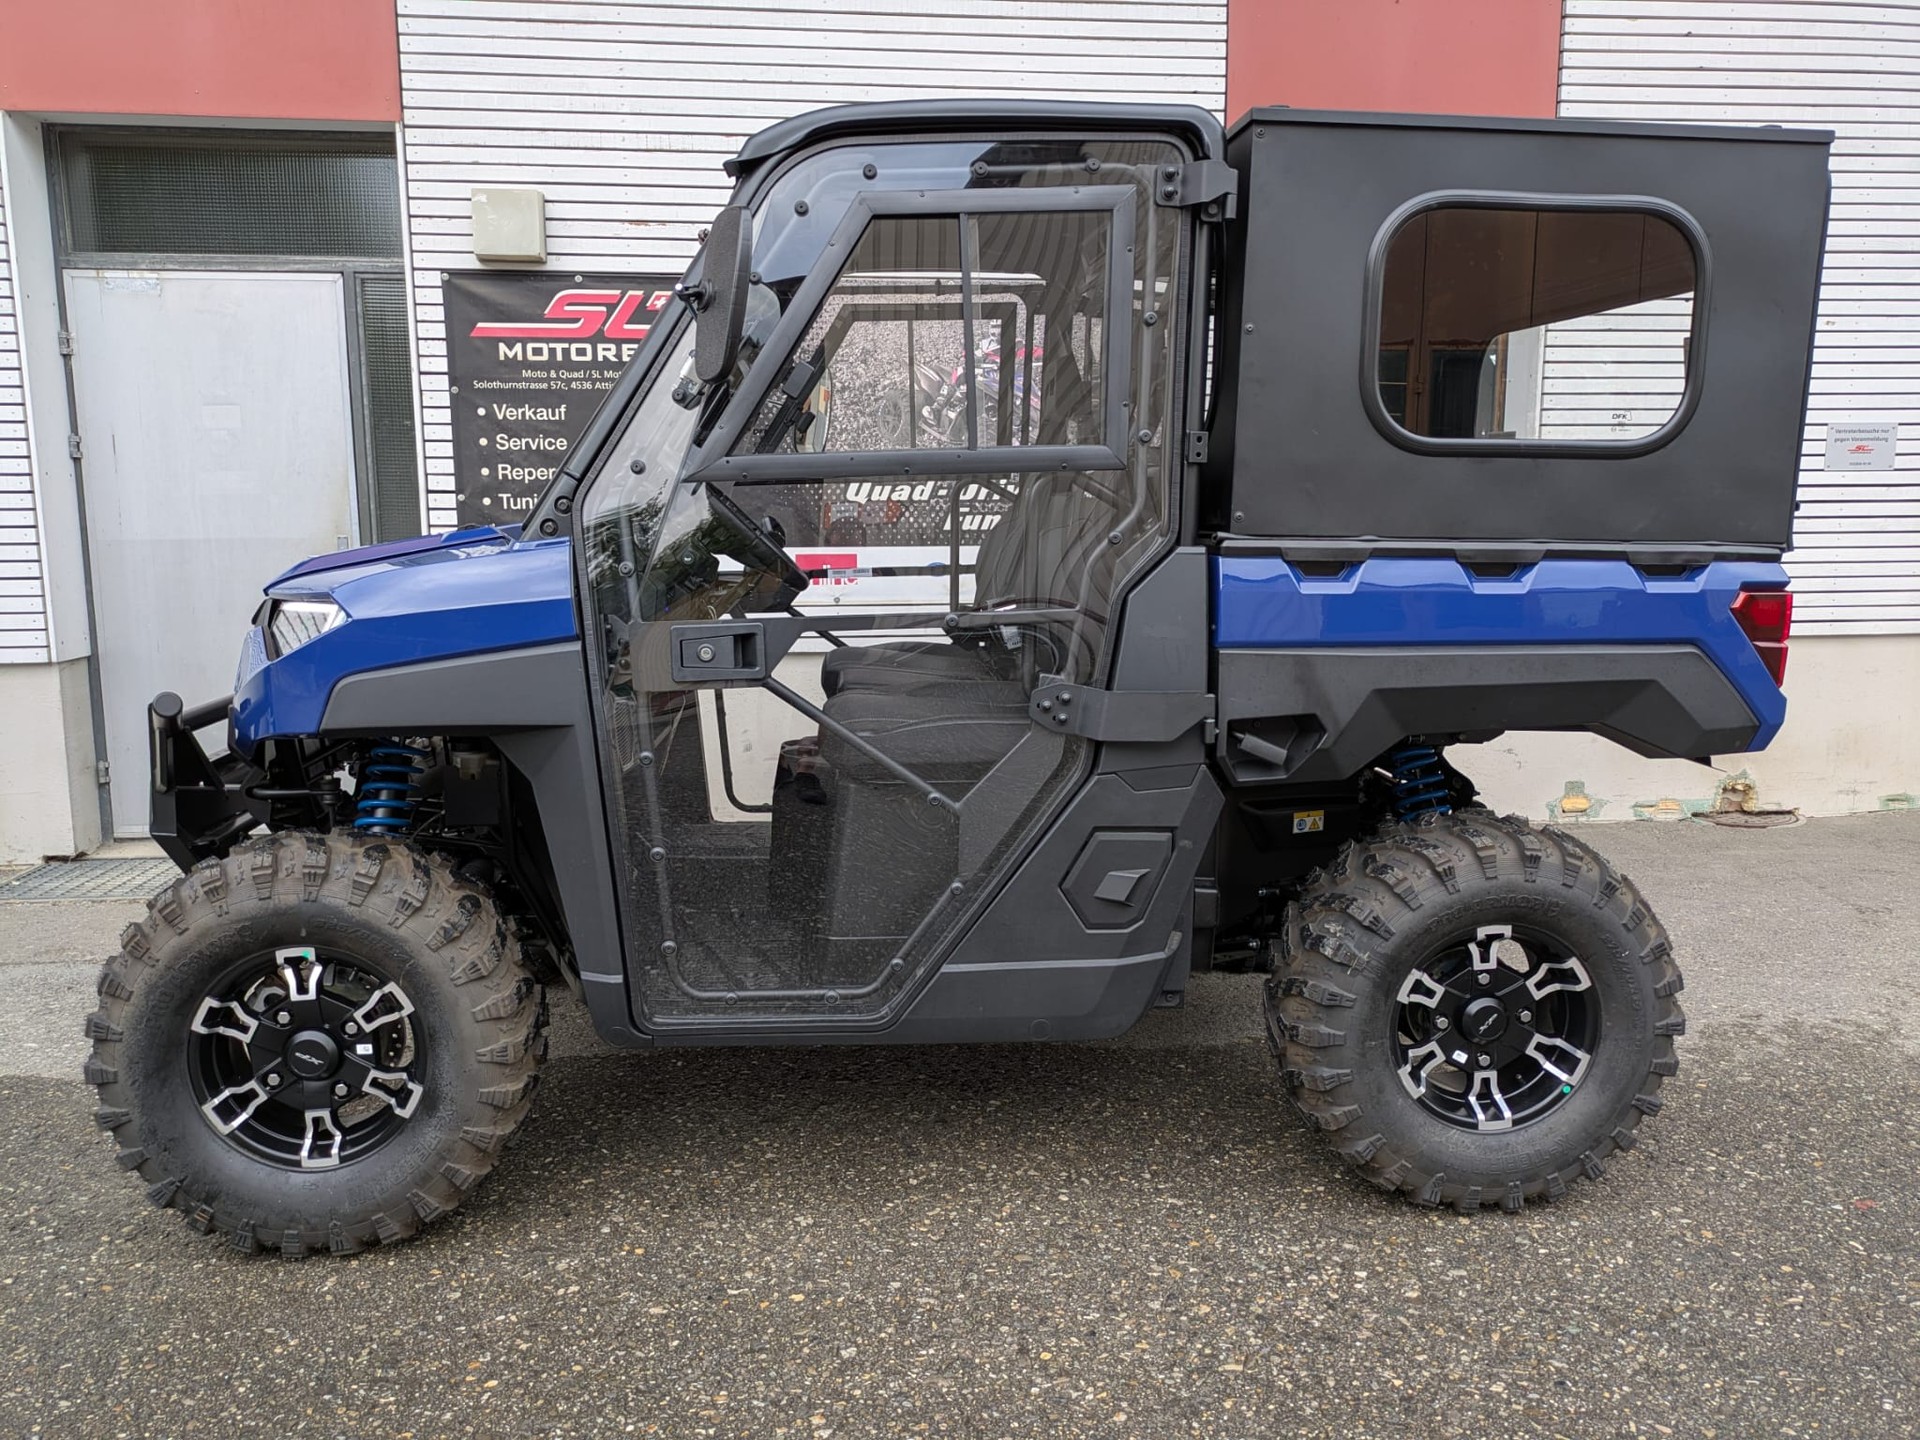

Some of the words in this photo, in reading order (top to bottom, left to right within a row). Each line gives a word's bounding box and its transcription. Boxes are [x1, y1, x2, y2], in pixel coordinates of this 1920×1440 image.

[498, 342, 640, 362] MOTORE
[522, 369, 547, 378] Moto
[550, 369, 557, 378] &
[559, 369, 584, 379] Quad
[585, 370, 590, 378] /
[591, 370, 602, 378] SL
[473, 380, 548, 390] Solothurnstrasse
[550, 381, 568, 391] 57c,
[570, 381, 593, 390] 4536
[493, 403, 567, 420] Verkauf
[495, 434, 568, 450] Service
[497, 464, 557, 484] Reper
[845, 481, 935, 504] Quad
[498, 493, 538, 510] Tuni
